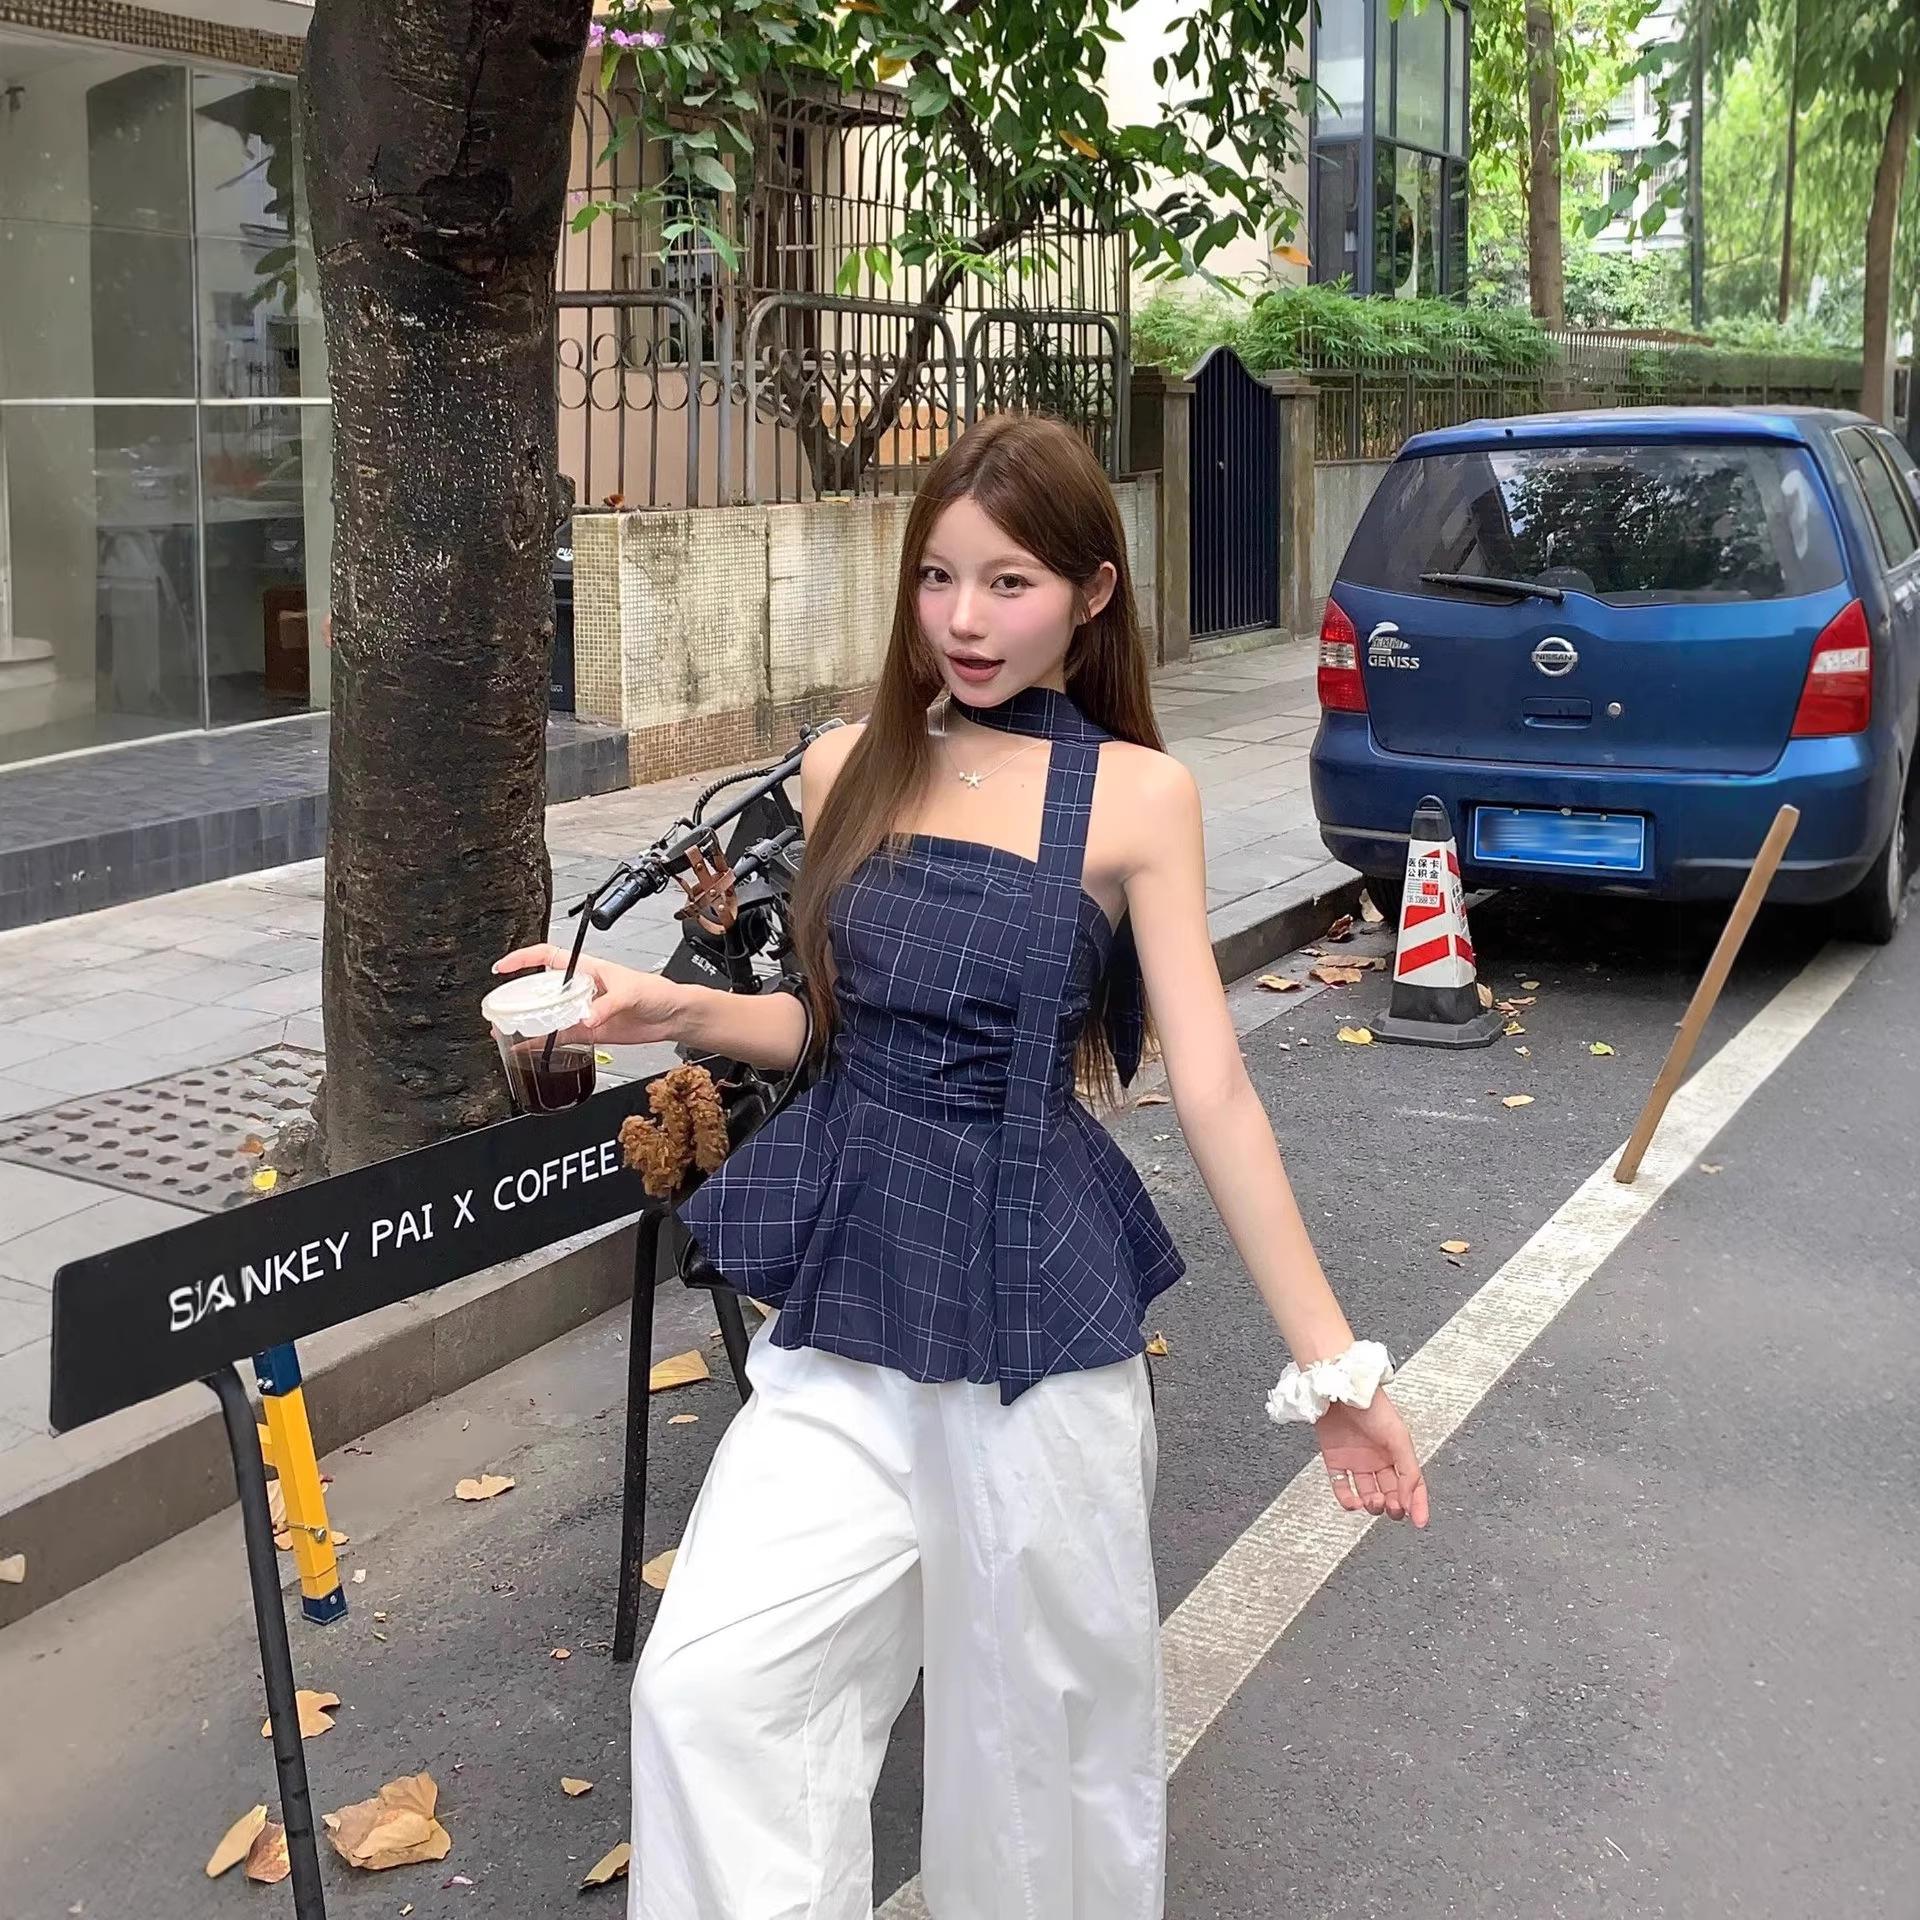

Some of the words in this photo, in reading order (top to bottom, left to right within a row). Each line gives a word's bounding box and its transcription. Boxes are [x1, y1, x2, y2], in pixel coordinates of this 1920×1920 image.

[1368, 655, 1420, 669] GENISS
[1535, 652, 1573, 661] NISSAN
[1408, 857, 1439, 869] 医保卡
[1408, 868, 1440, 879] 公积金
[371, 1203, 434, 1257] PAI
[453, 1189, 475, 1229] X
[493, 1139, 619, 1211] COFFEE
